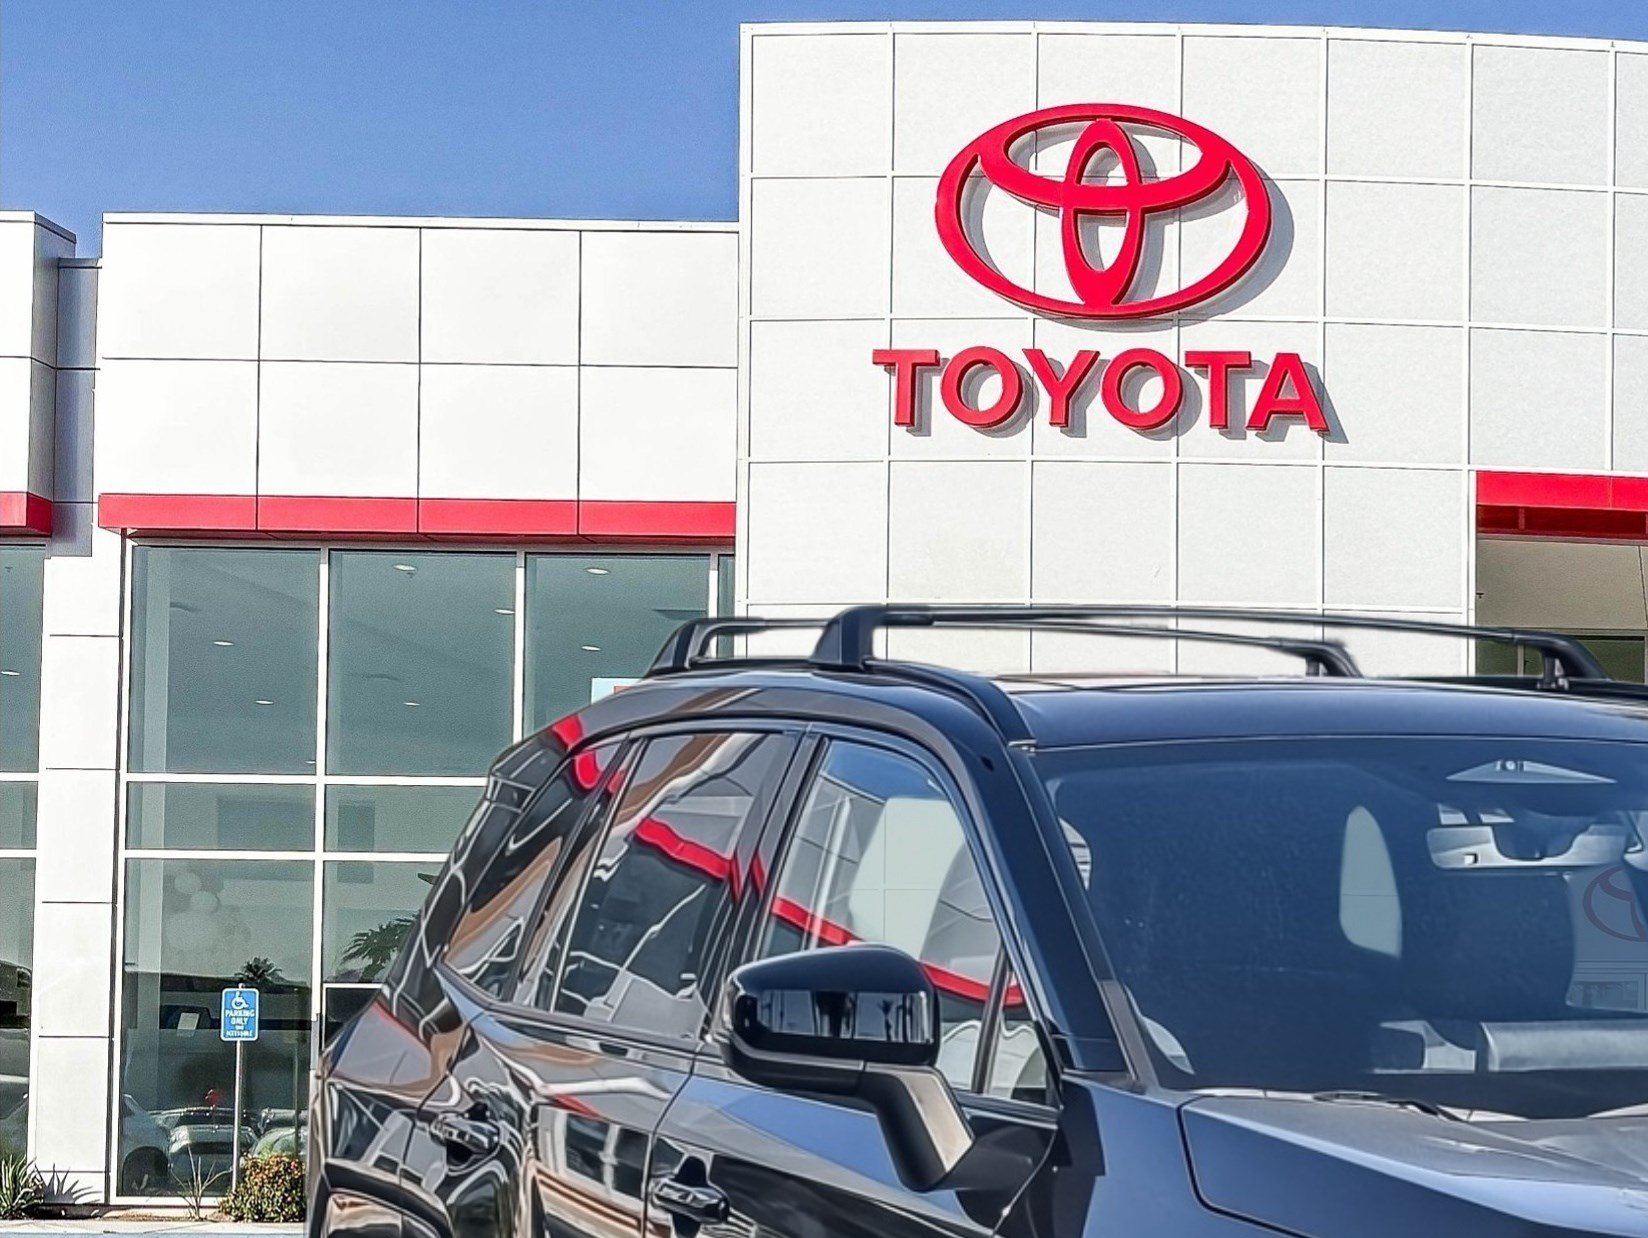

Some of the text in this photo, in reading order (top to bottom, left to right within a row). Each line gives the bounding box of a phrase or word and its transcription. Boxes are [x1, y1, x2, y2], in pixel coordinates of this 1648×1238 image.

[872, 346, 1329, 432] TOYOTA
[225, 1009, 255, 1017] PARKING
[230, 1017, 249, 1025] ONLY
